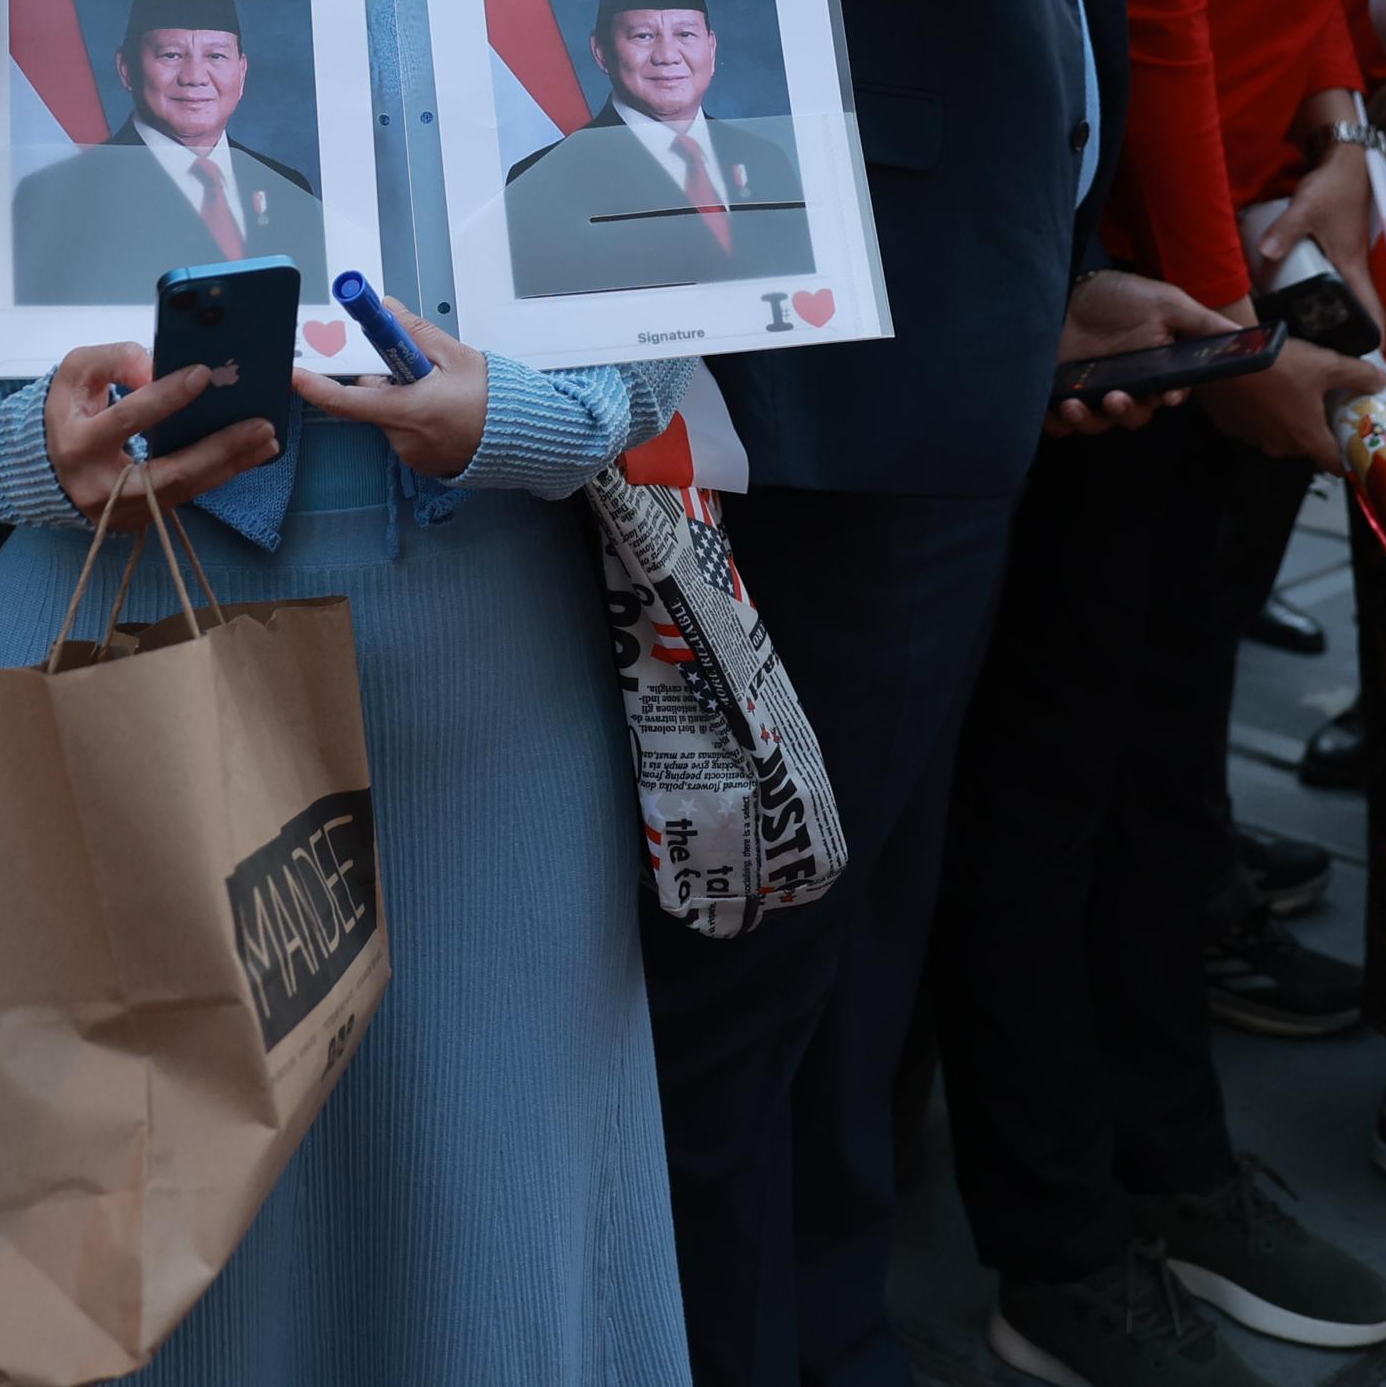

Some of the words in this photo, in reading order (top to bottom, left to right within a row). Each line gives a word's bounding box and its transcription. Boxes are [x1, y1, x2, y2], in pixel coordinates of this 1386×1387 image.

[760, 292, 794, 332] I
[637, 329, 706, 344] Signature
[665, 770, 703, 781] peeping
[666, 818, 698, 864] the
[240, 814, 367, 1019] MANDEE
